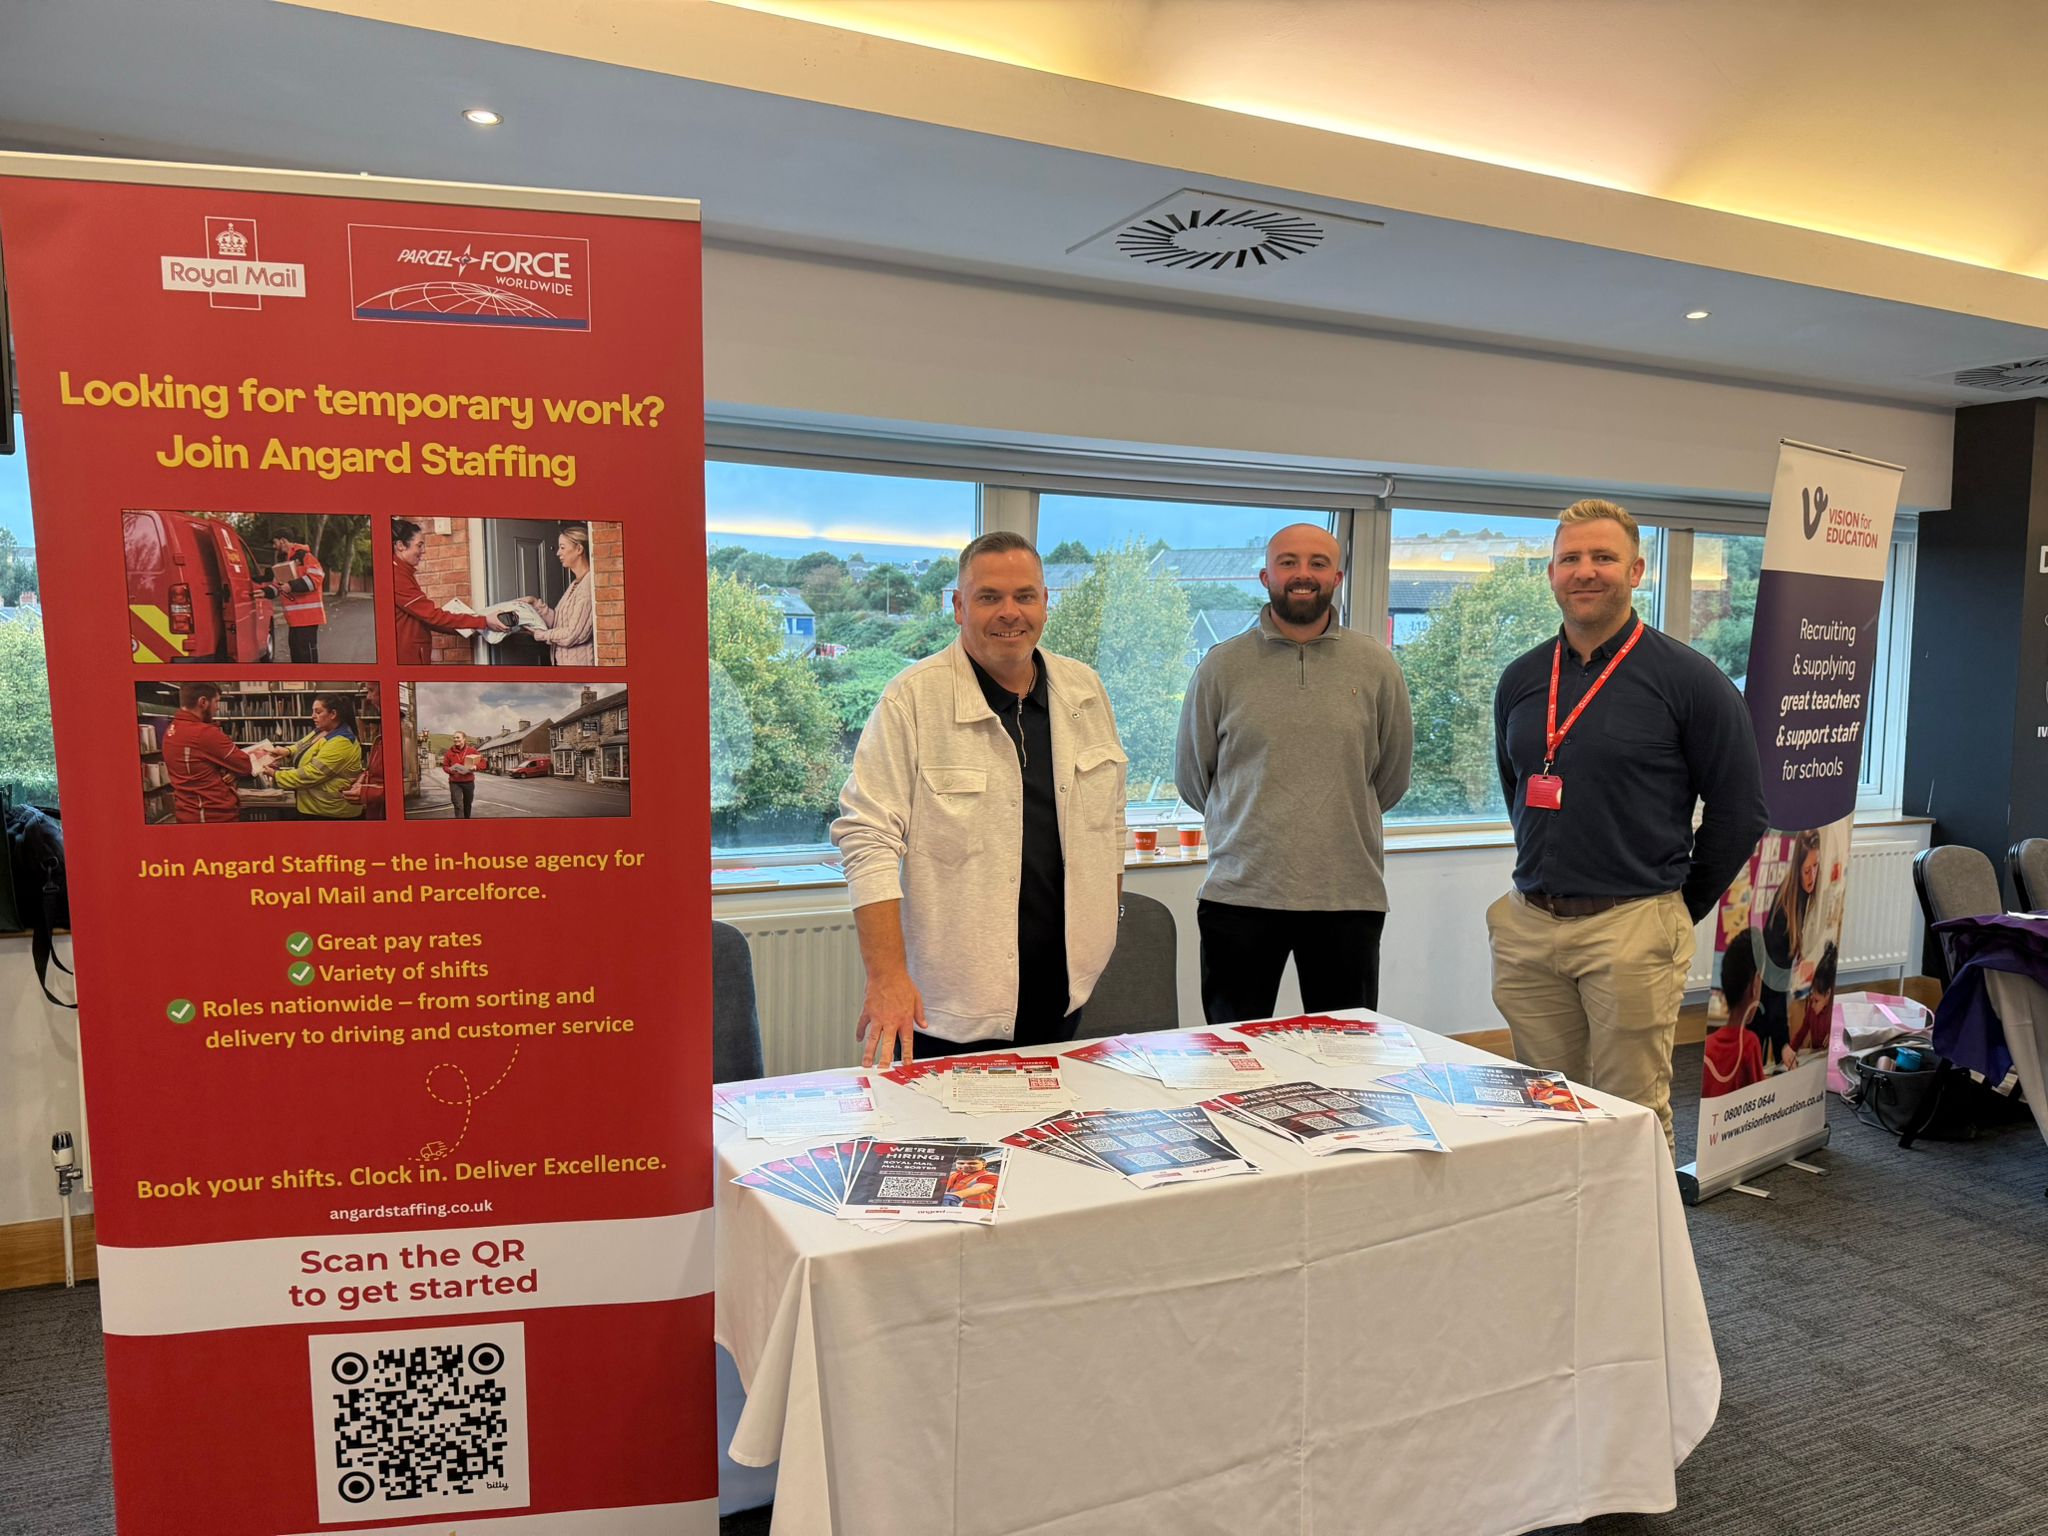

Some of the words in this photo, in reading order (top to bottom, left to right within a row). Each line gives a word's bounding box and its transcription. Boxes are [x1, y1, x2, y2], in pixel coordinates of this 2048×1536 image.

[171, 262, 238, 287] Royal
[245, 267, 296, 287] Mail
[398, 250, 452, 267] PARCEL
[480, 251, 572, 279] FORCE
[495, 275, 573, 297] WORLDWIDE
[60, 372, 228, 418] Looking
[239, 378, 306, 412] for
[314, 384, 533, 429] temporary
[543, 394, 664, 427] work?
[157, 435, 248, 468] Join
[260, 438, 410, 480] Angard
[422, 443, 575, 486] Staffing
[1828, 508, 1859, 528] VISION
[1861, 513, 1873, 530] for
[1826, 527, 1879, 549] EDUCATION
[1800, 618, 1856, 647] Recruiting
[1793, 654, 1800, 675] &
[1802, 655, 1855, 680] supplying
[1780, 691, 1810, 716] great
[1812, 689, 1860, 709] teachers
[1776, 725, 1785, 746] &
[1786, 725, 1829, 750] support
[1831, 722, 1860, 742] staff
[1783, 760, 1798, 780] for
[1799, 756, 1843, 778] schools
[139, 859, 185, 877] Join
[193, 856, 274, 878] Angard
[282, 855, 366, 876] Staffing
[391, 854, 427, 871] the
[435, 852, 528, 870] in-house
[535, 855, 608, 871] agency
[614, 850, 644, 866] for
[251, 887, 310, 908] Royal
[319, 886, 365, 904] Mail
[373, 885, 412, 903] and
[421, 883, 546, 901] Parcelforce.
[318, 934, 377, 950] Great
[385, 936, 422, 953] pay
[430, 932, 481, 947] rates
[319, 964, 395, 984] Variety
[403, 962, 424, 979] of
[431, 960, 488, 978] shifts
[203, 999, 263, 1017] Roles
[271, 994, 392, 1013] nationwide
[418, 993, 469, 1009] from
[477, 989, 550, 1008] sorting
[557, 987, 594, 1004] and
[206, 1030, 295, 1048] delivery
[302, 1029, 324, 1043] to
[331, 1026, 404, 1045] driving
[411, 1022, 450, 1040] and
[458, 1022, 556, 1038] customer
[563, 1016, 633, 1033] service
[1709, 1132, 1718, 1146] W
[1721, 1093, 1825, 1141] www.visionforeducation.co.uk
[1712, 1114, 1719, 1126] T
[1723, 1105, 1742, 1122] 0800
[886, 1153, 945, 1161] HIRING!
[889, 1146, 936, 1154] WE'RE
[138, 1177, 200, 1198] Book
[207, 1177, 264, 1198] your
[272, 1169, 342, 1189] shifts.
[350, 1166, 412, 1185] Clock
[420, 1165, 447, 1182] in.
[456, 1160, 537, 1180] Deliver
[545, 1155, 666, 1175] Excellence.
[330, 1200, 492, 1222] angardstaffing.co.uk
[301, 1251, 387, 1273] Scan
[399, 1244, 460, 1268] the
[472, 1240, 524, 1268] QR
[289, 1286, 326, 1306] to
[338, 1281, 398, 1310] get
[410, 1269, 537, 1300] started
